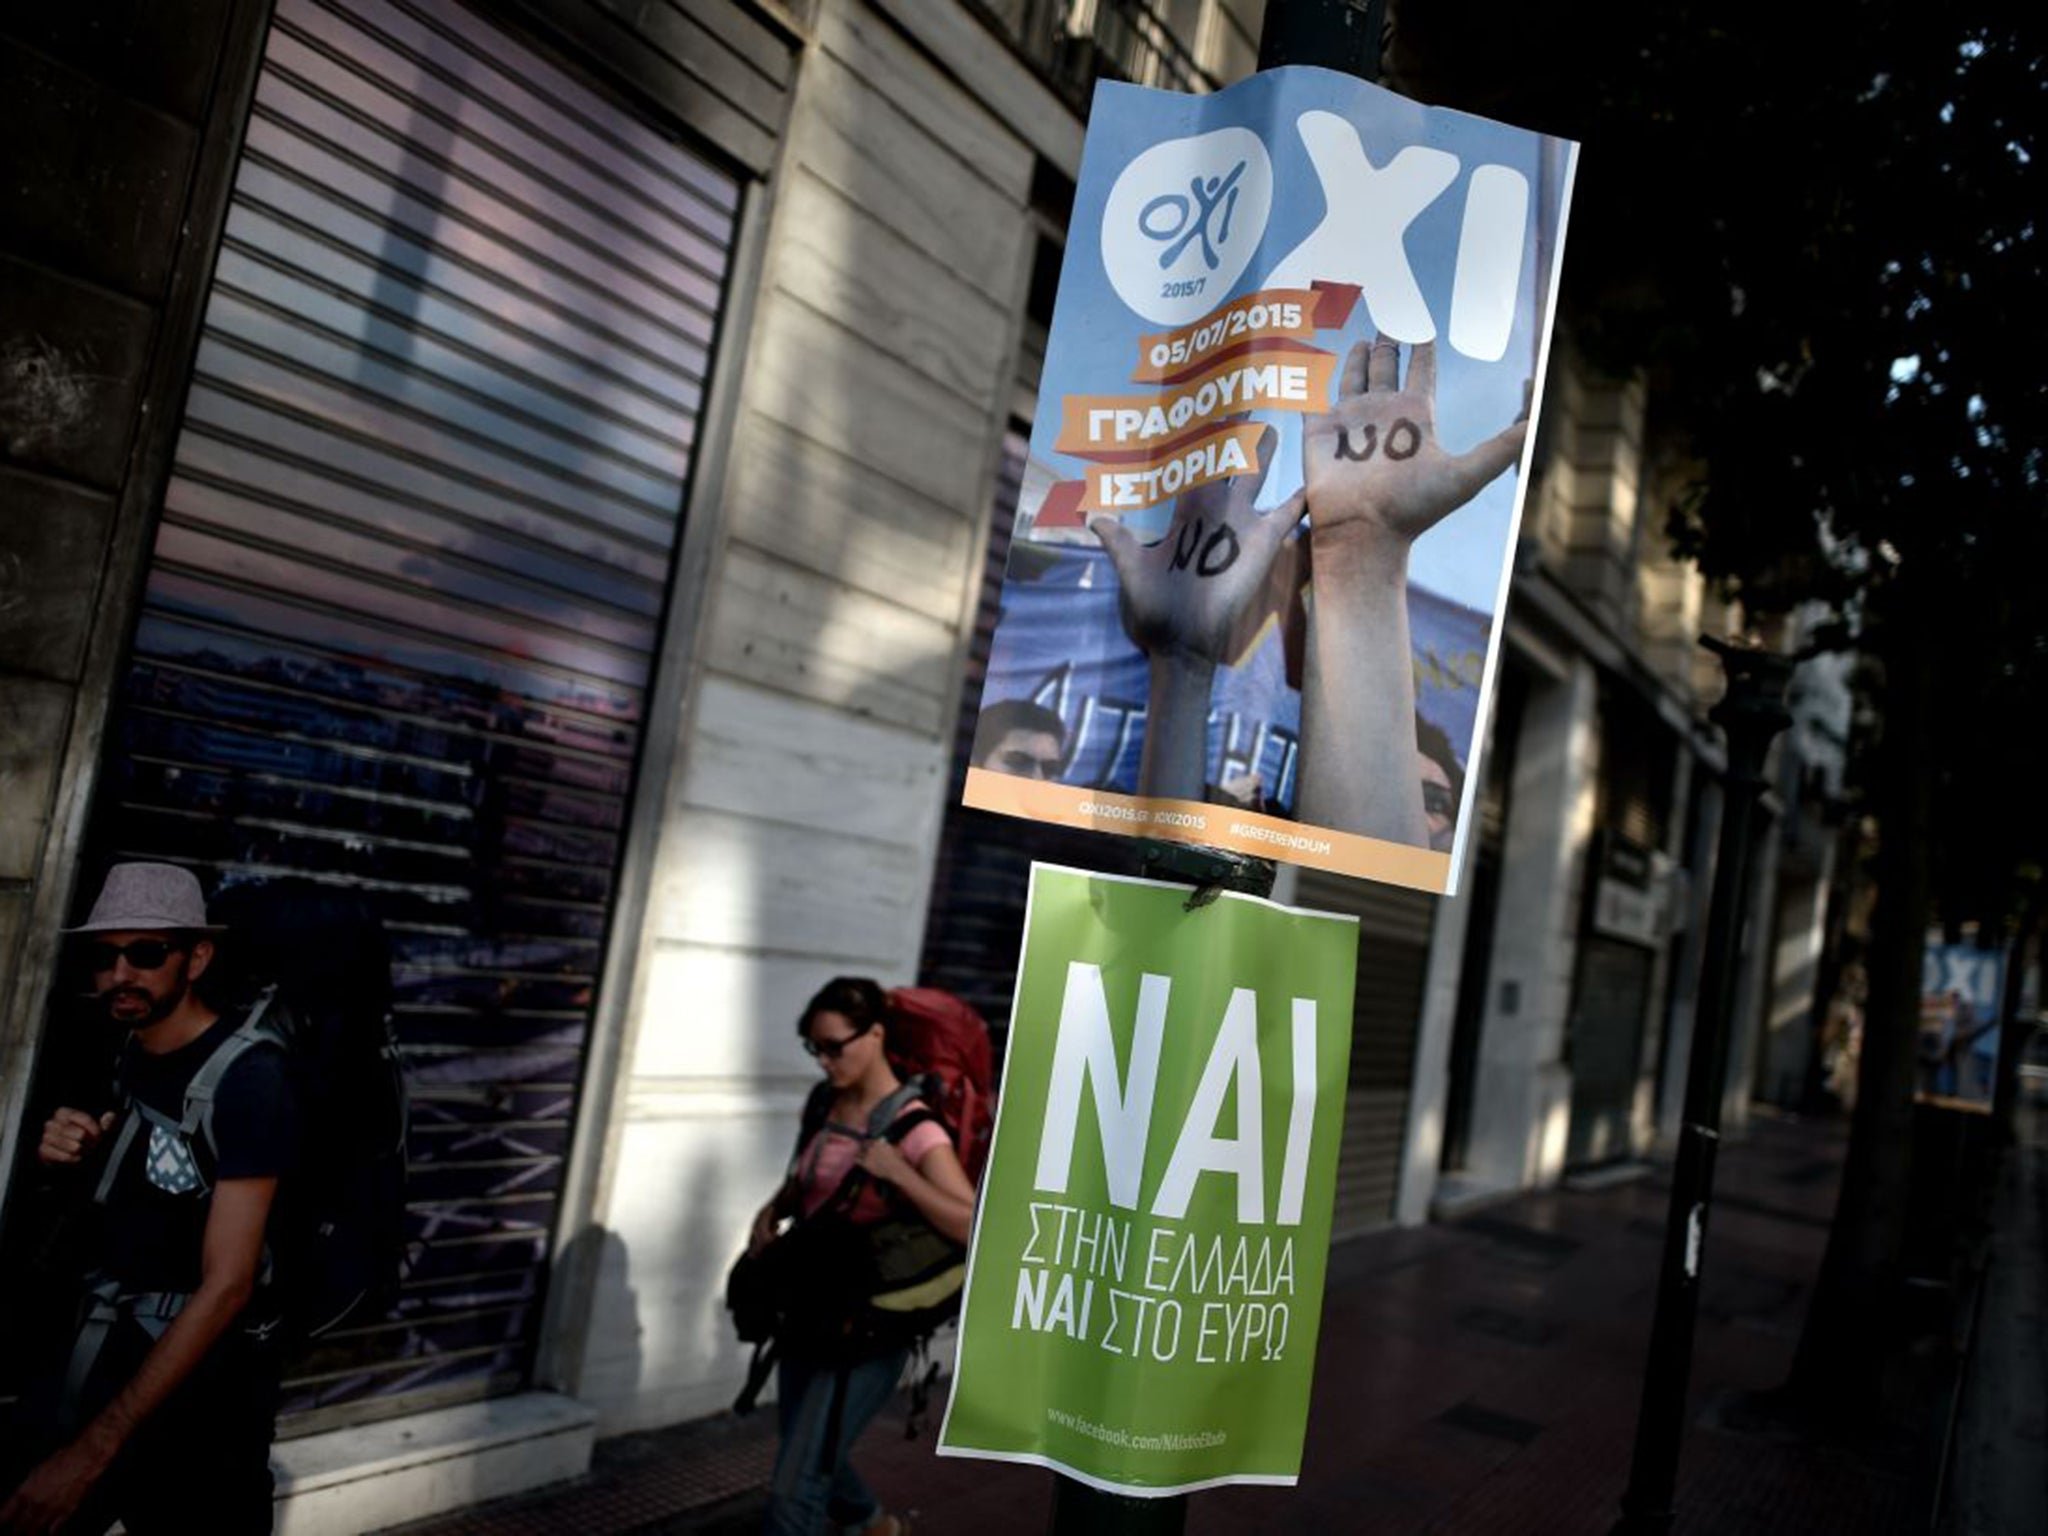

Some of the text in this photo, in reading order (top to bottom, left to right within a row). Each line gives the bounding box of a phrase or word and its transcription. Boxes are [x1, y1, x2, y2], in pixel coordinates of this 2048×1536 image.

[1139, 161, 1246, 270] ΟΧΙ
[1162, 278, 1207, 298] 2015/7
[1150, 303, 1302, 367] 05/07/2015
[1088, 365, 1309, 441] ΓΡΑΦΟΥΜΕ
[1100, 437, 1249, 506] ΙΣΤΟΡΙΑ
[1334, 418, 1422, 461] NO
[1168, 519, 1241, 577] NO
[1230, 823, 1332, 855] #GREFERENDUM
[1033, 960, 1318, 1226] ΝΑΙ
[1020, 1202, 1295, 1296] ΣΤΗΝ ΕΛΛΑΔΑ
[1012, 1268, 1289, 1363] ΝΑΙ ΣΤΟ ΕΥΡΩ
